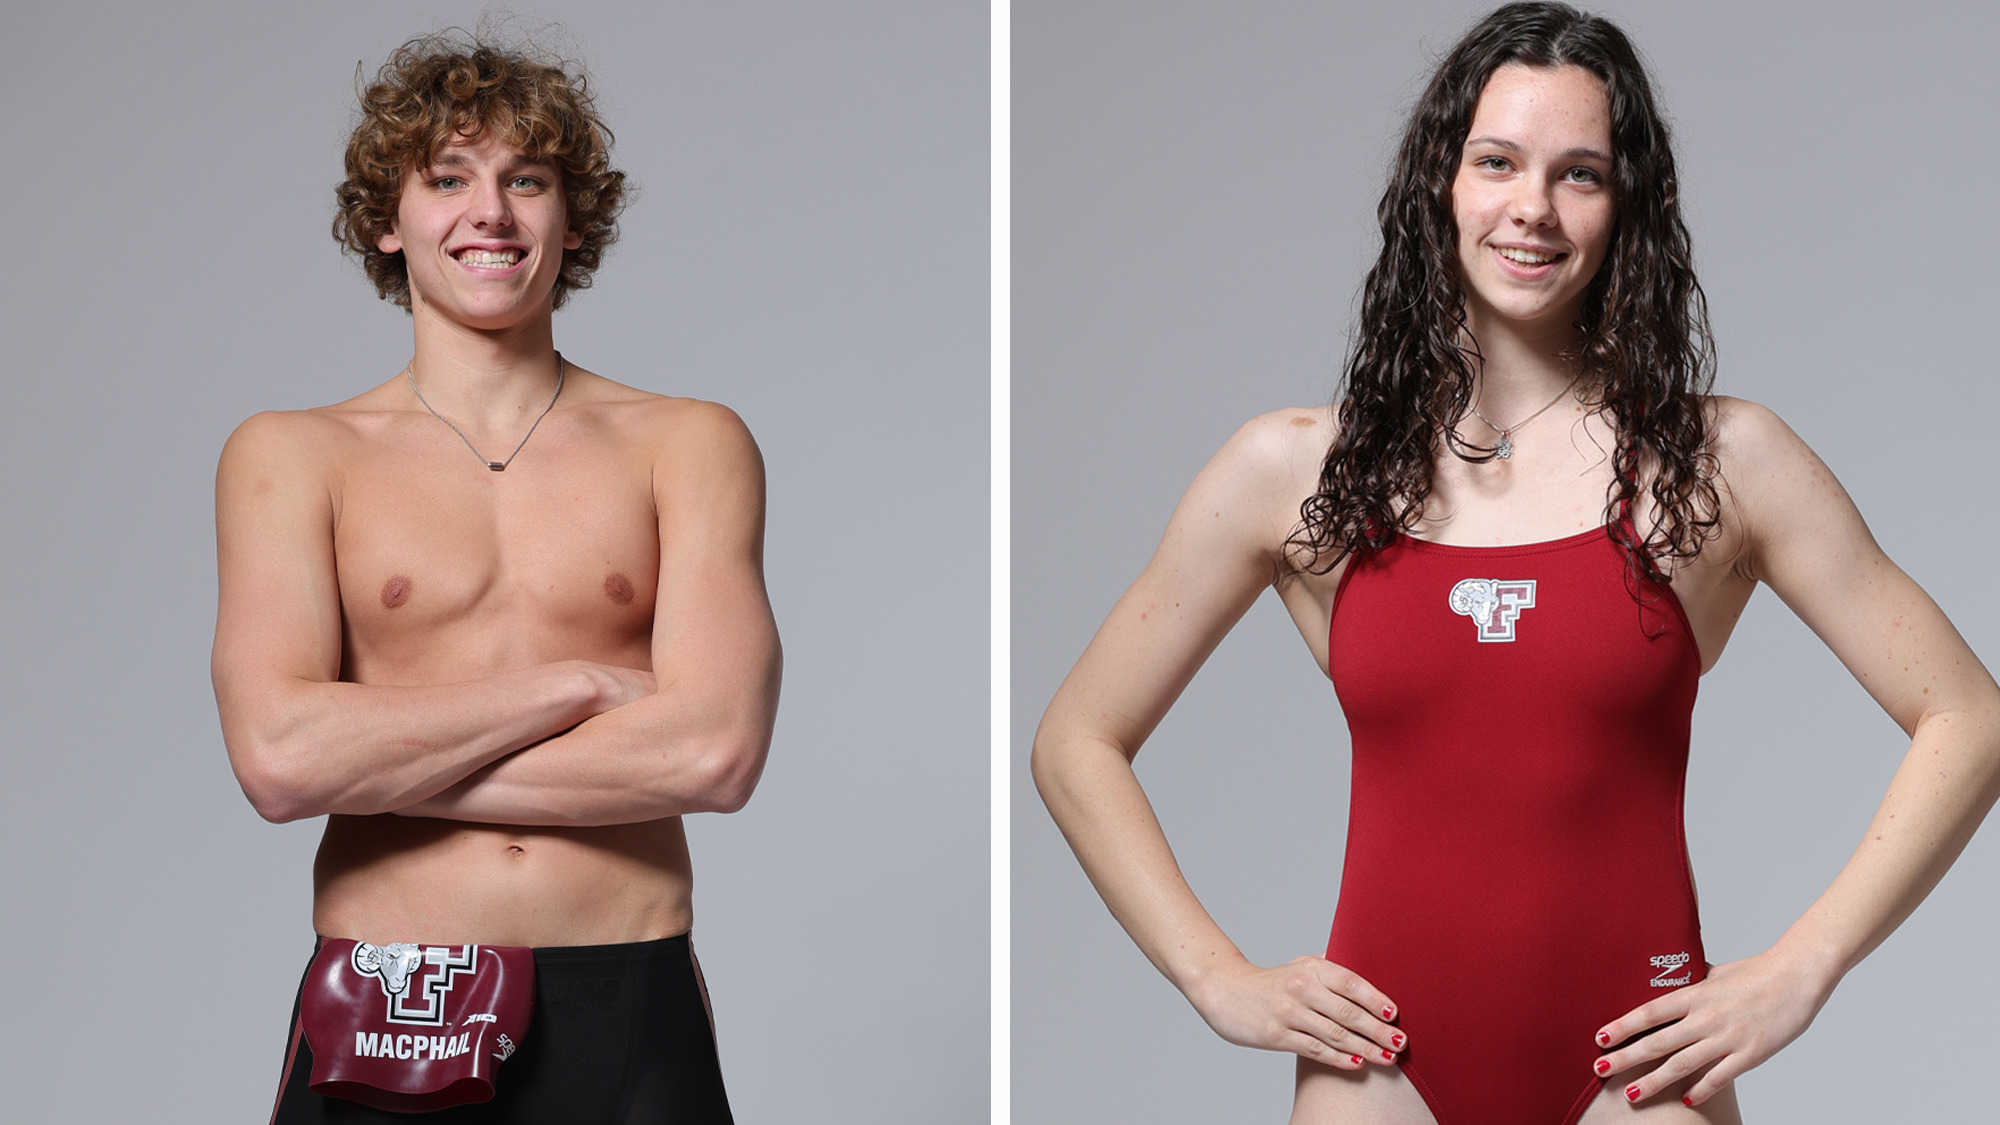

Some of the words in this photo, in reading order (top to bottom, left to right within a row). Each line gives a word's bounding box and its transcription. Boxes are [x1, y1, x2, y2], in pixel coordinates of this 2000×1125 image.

[1478, 579, 1537, 643] F
[1649, 951, 1690, 968] speedo
[355, 1031, 470, 1060] MACPHAIL
